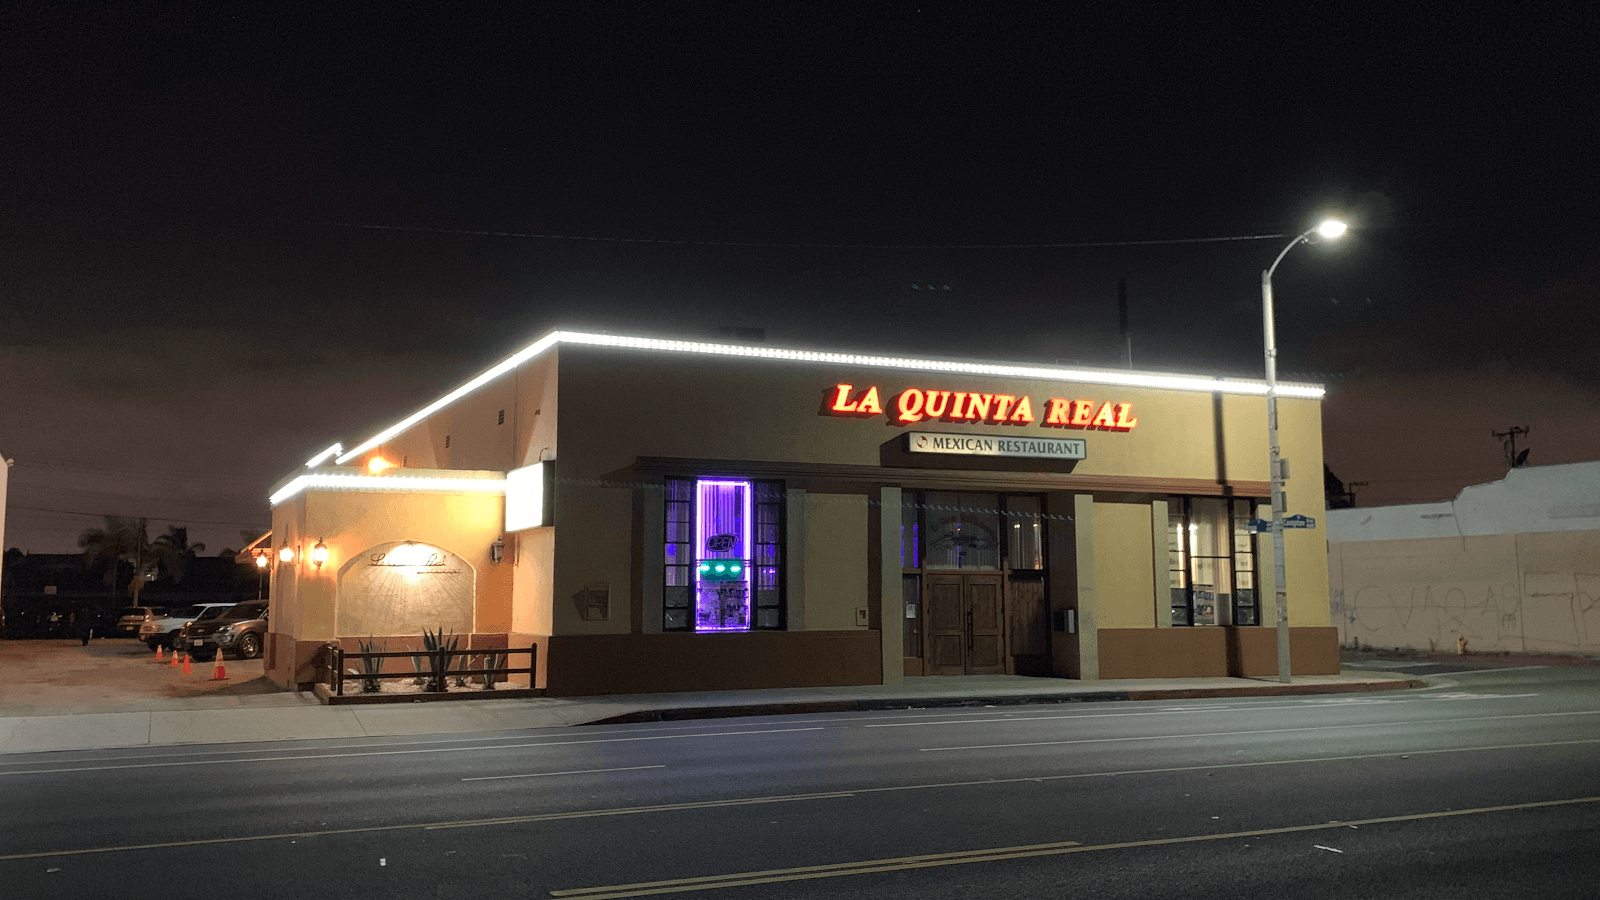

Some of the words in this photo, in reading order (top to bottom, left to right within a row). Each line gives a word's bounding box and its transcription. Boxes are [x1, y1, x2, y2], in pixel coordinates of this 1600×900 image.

[831, 383, 882, 414] LA
[898, 388, 1034, 422] QUINTA
[1046, 397, 1139, 429] REAL
[933, 437, 993, 451] MEXICAN
[998, 440, 1079, 455] RESTAURANT
[708, 536, 736, 549] OPEN
